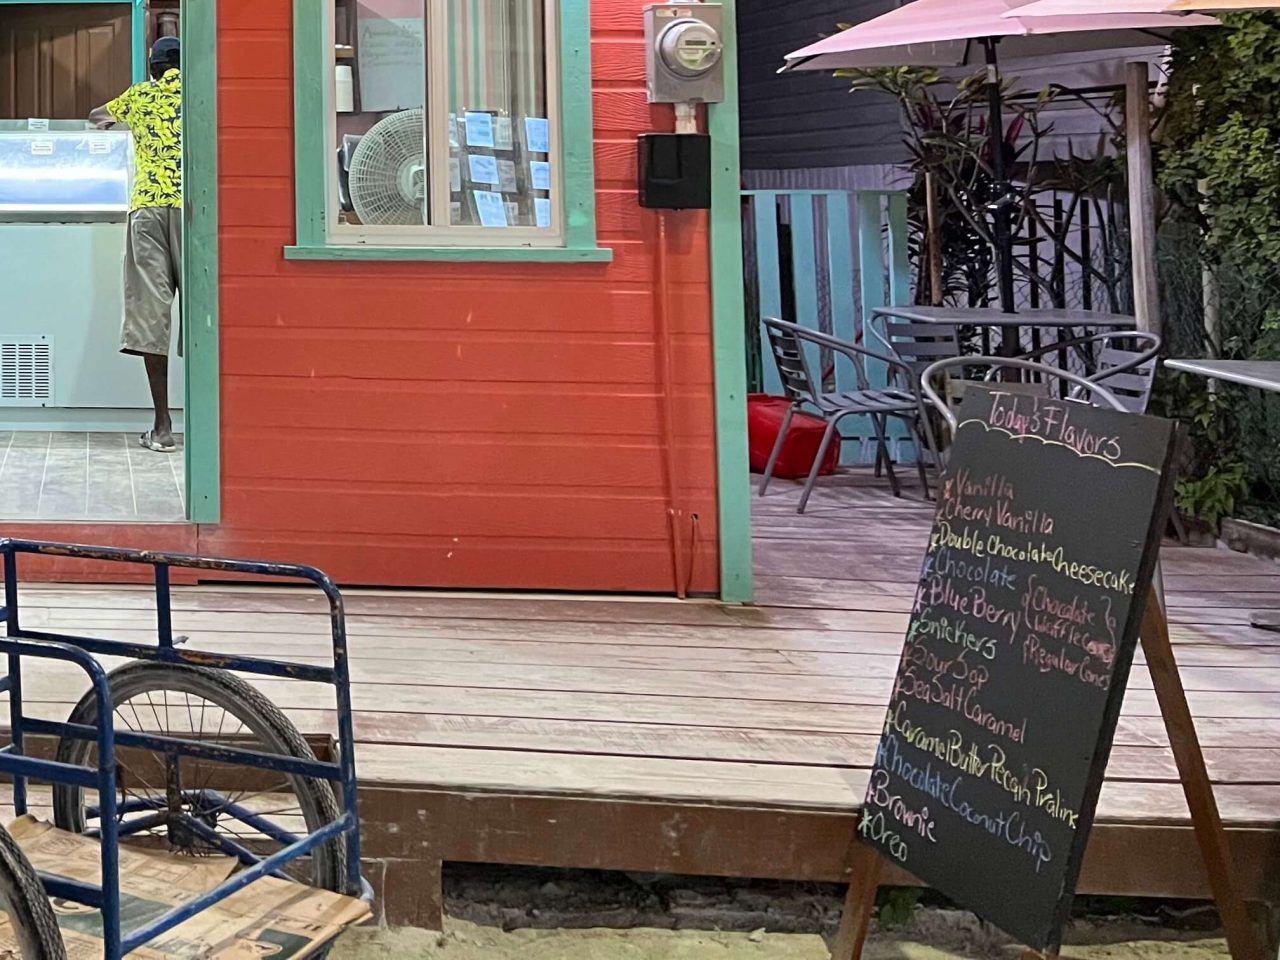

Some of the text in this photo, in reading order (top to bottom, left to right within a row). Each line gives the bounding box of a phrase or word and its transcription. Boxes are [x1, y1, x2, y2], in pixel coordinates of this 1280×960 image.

[988, 391, 1122, 460] Today's Flavors
[956, 468, 1014, 500] Vanilla
[945, 497, 1054, 535] Cherry Vanilla
[934, 547, 1017, 590] Chocolate
[938, 521, 985, 557] Double
[986, 533, 1053, 565] Chocolate
[1032, 586, 1096, 626] Chocolate
[1034, 614, 1082, 646] Waffle
[918, 607, 998, 660] Snickers
[1028, 634, 1081, 675] Regular
[911, 634, 989, 691] Sour Sop
[903, 665, 1028, 744] Sea Salt Caramel
[894, 700, 950, 762] Caramel
[949, 728, 990, 778] Butter
[873, 769, 937, 843] Brownie
[883, 734, 1053, 873] Chocolate Coconut Chip
[871, 810, 909, 863] Oreo
